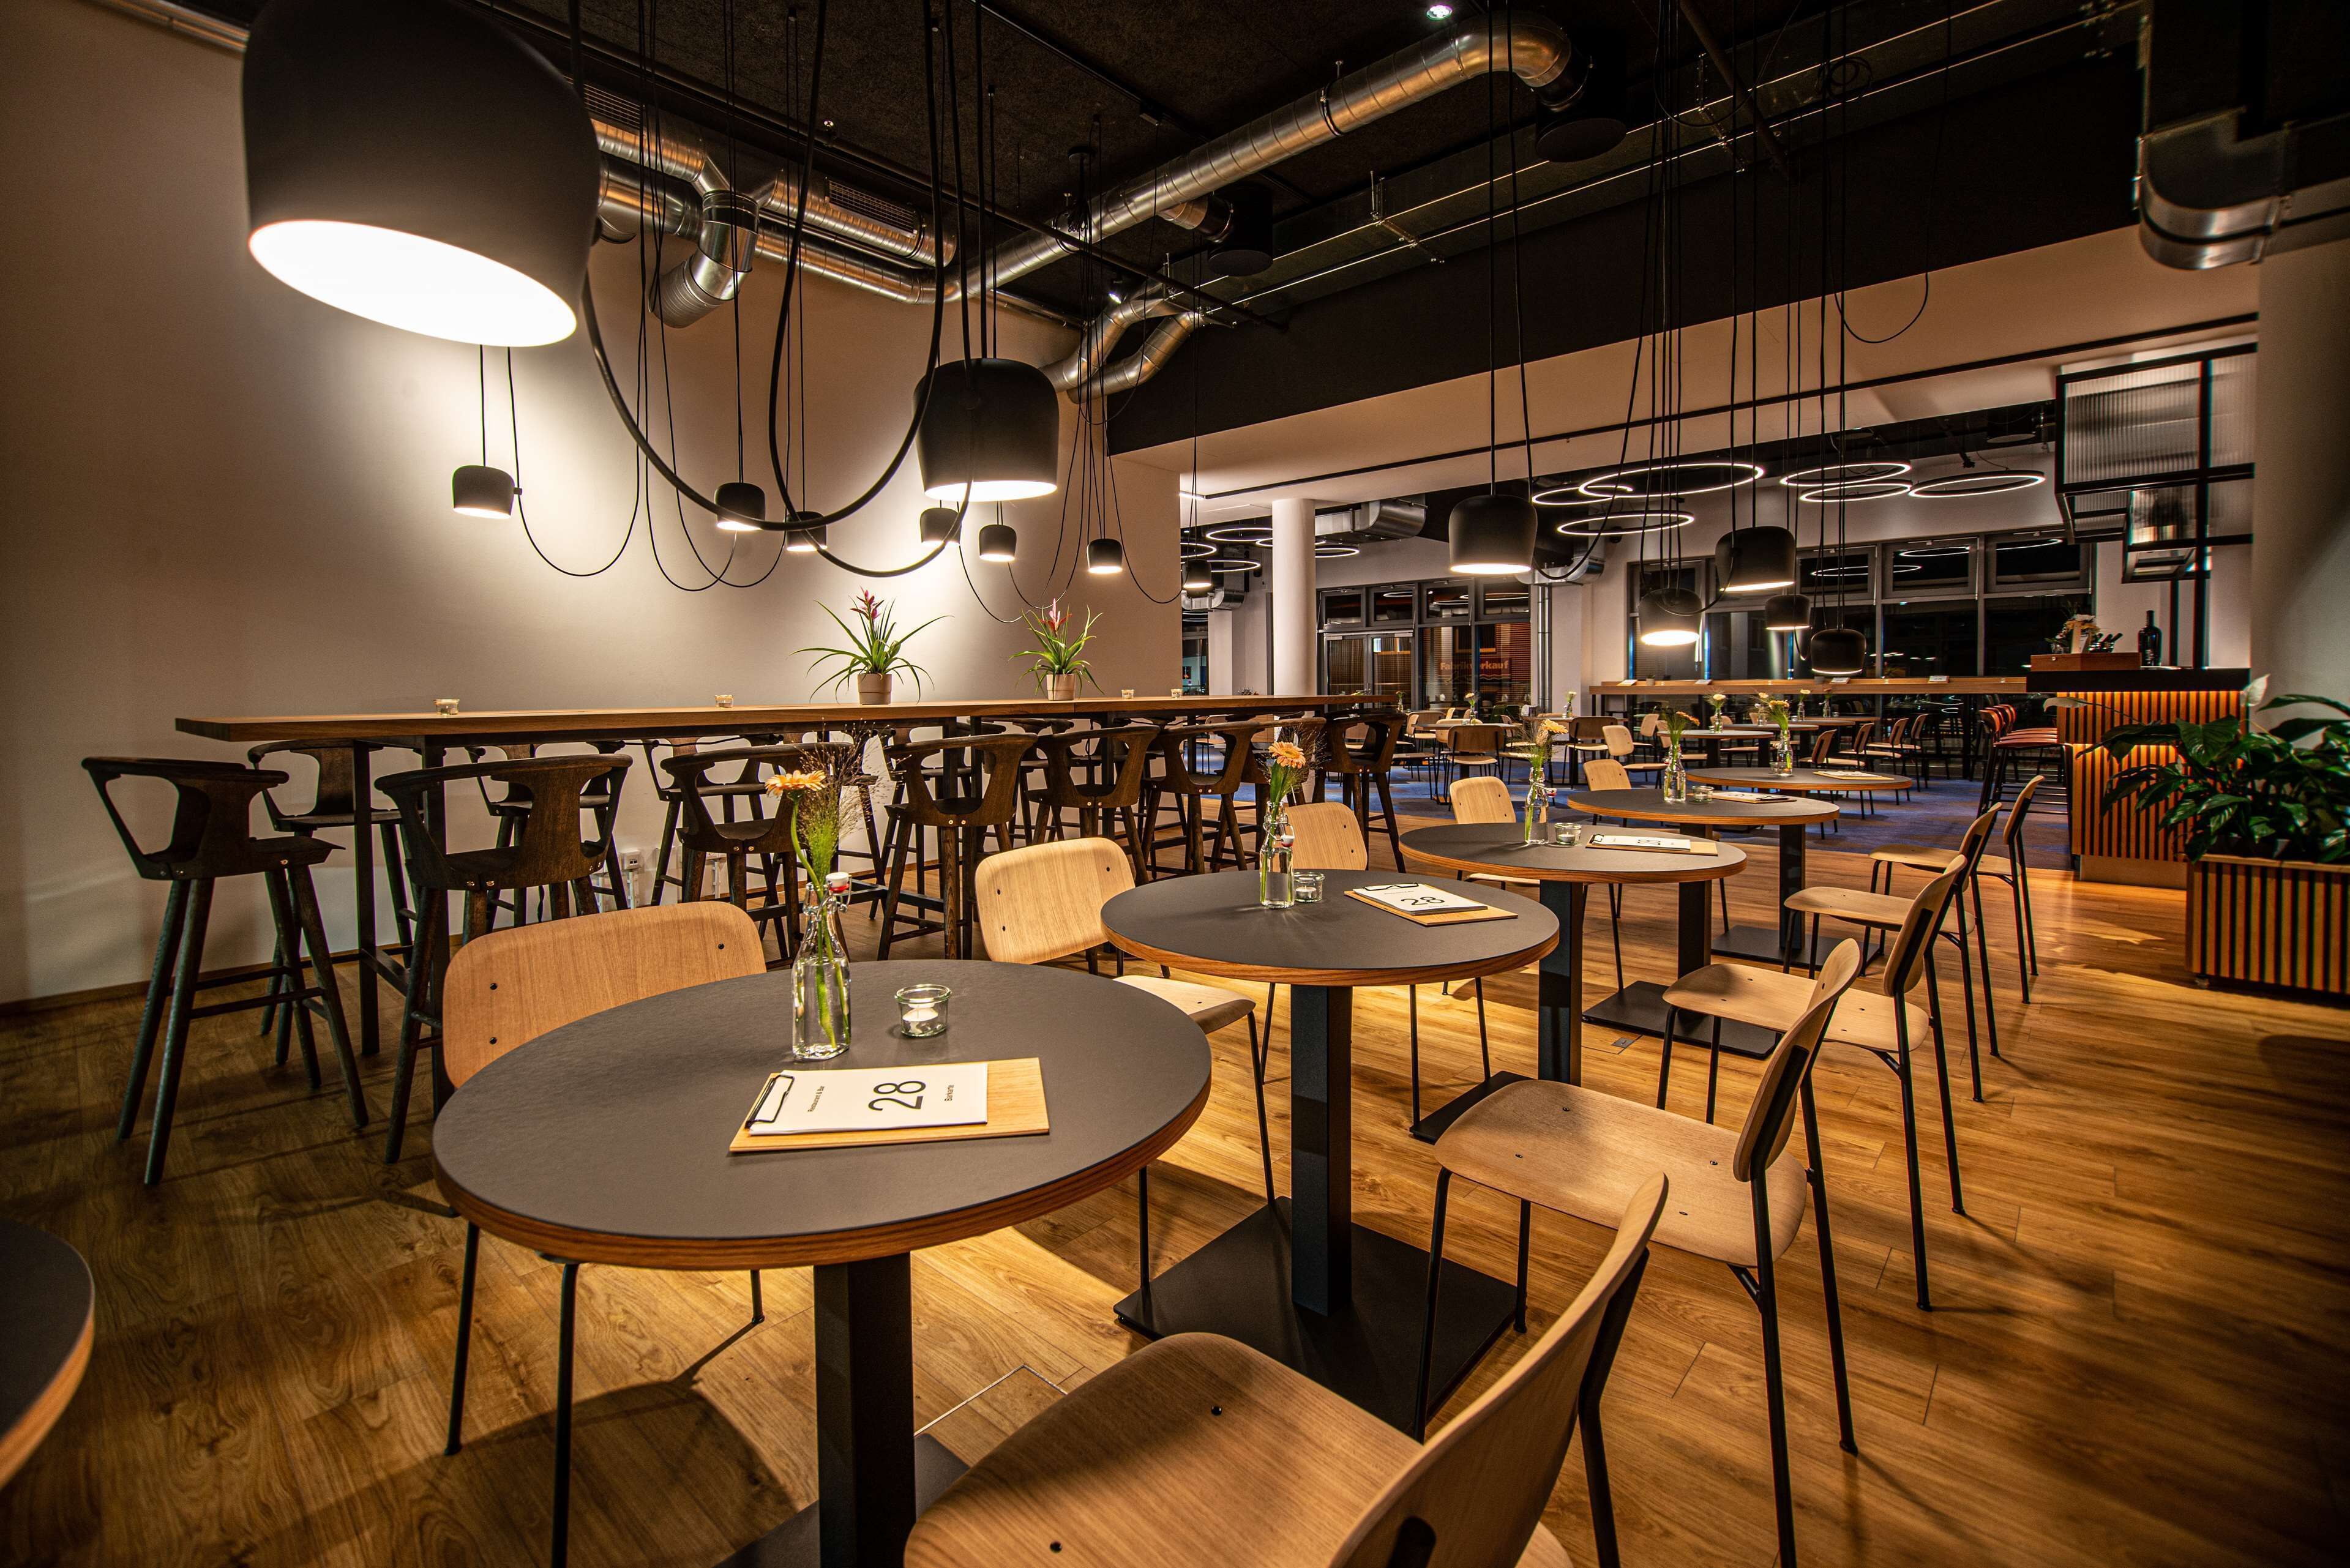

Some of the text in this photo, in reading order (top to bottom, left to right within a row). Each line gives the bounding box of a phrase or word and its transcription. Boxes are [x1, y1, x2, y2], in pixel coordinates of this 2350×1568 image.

[1440, 660, 1509, 670] Fabrikvrkauf
[1401, 896, 1445, 906] 28
[868, 1080, 926, 1111] 28
